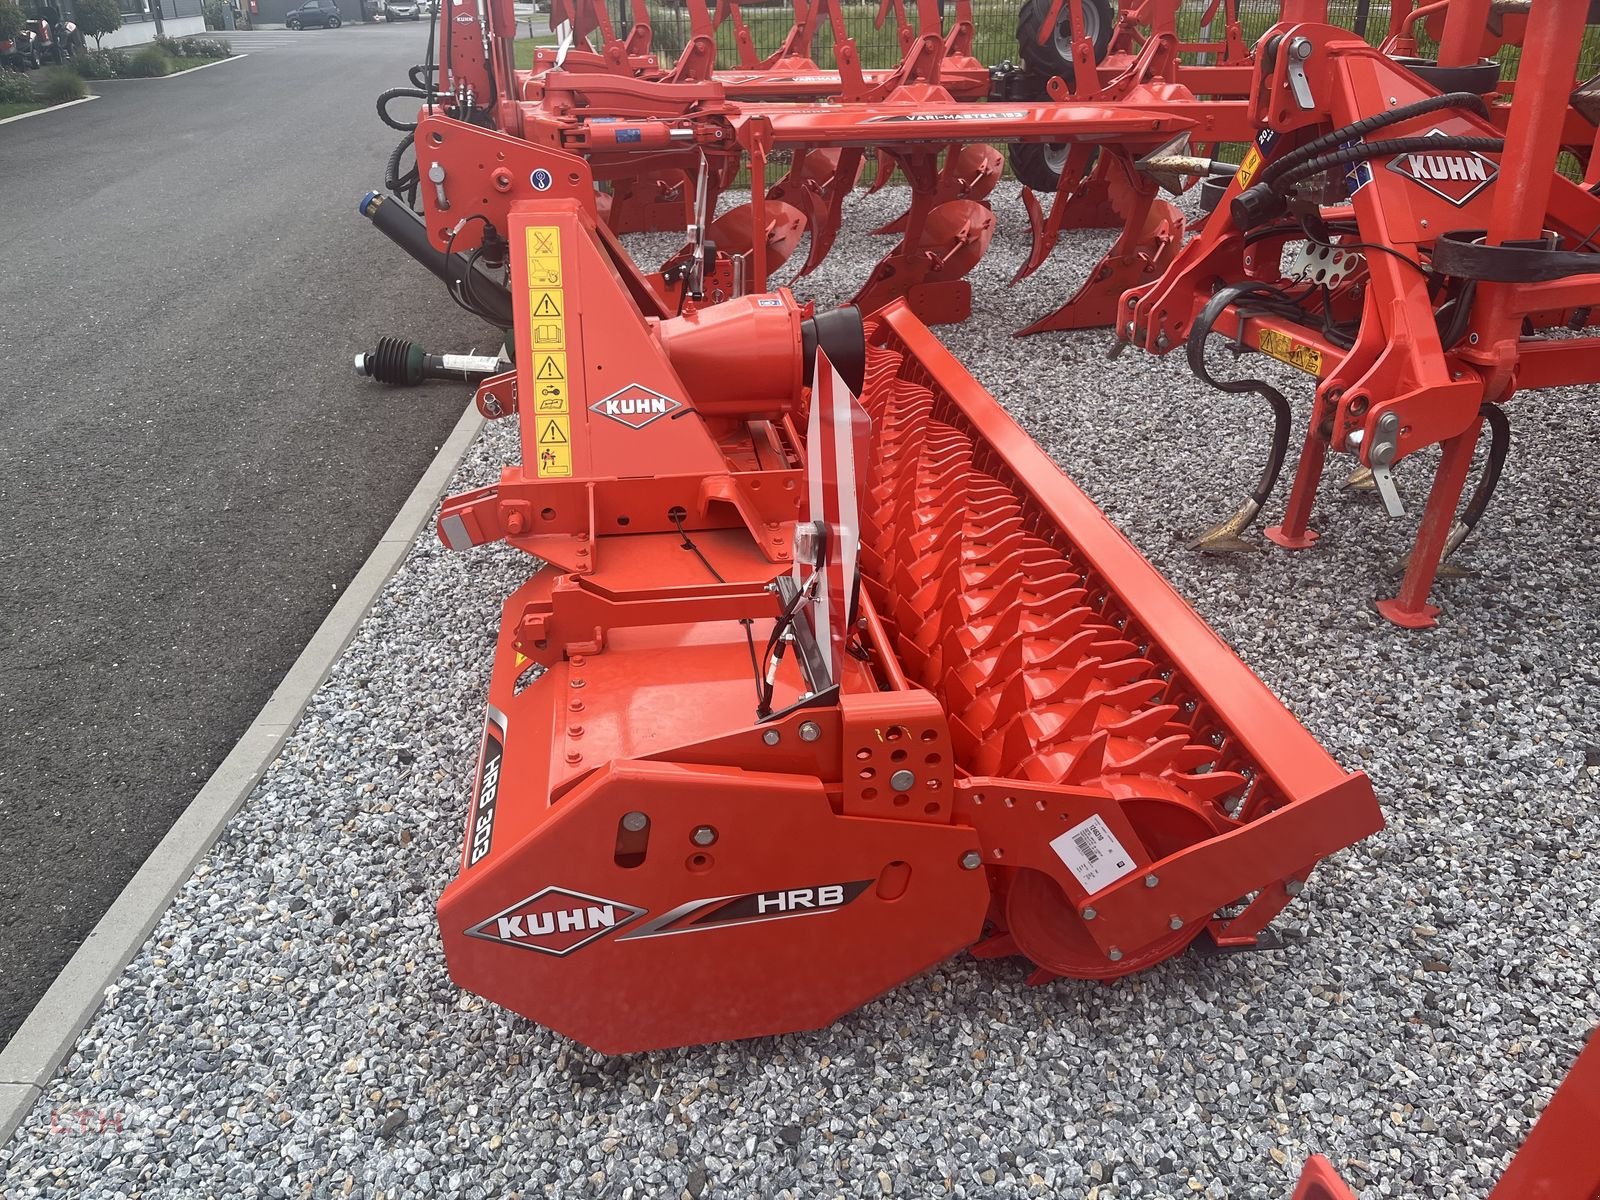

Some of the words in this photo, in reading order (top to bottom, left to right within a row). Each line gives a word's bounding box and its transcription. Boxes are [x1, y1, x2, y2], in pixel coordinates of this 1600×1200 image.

[906, 112, 997, 121] VARI-MASTER
[1407, 154, 1488, 182] KUHN
[606, 398, 666, 415] KUHN
[480, 754, 501, 798] HRB
[472, 812, 494, 865] 303
[757, 884, 845, 914] HRB
[498, 905, 615, 939] KUHN
